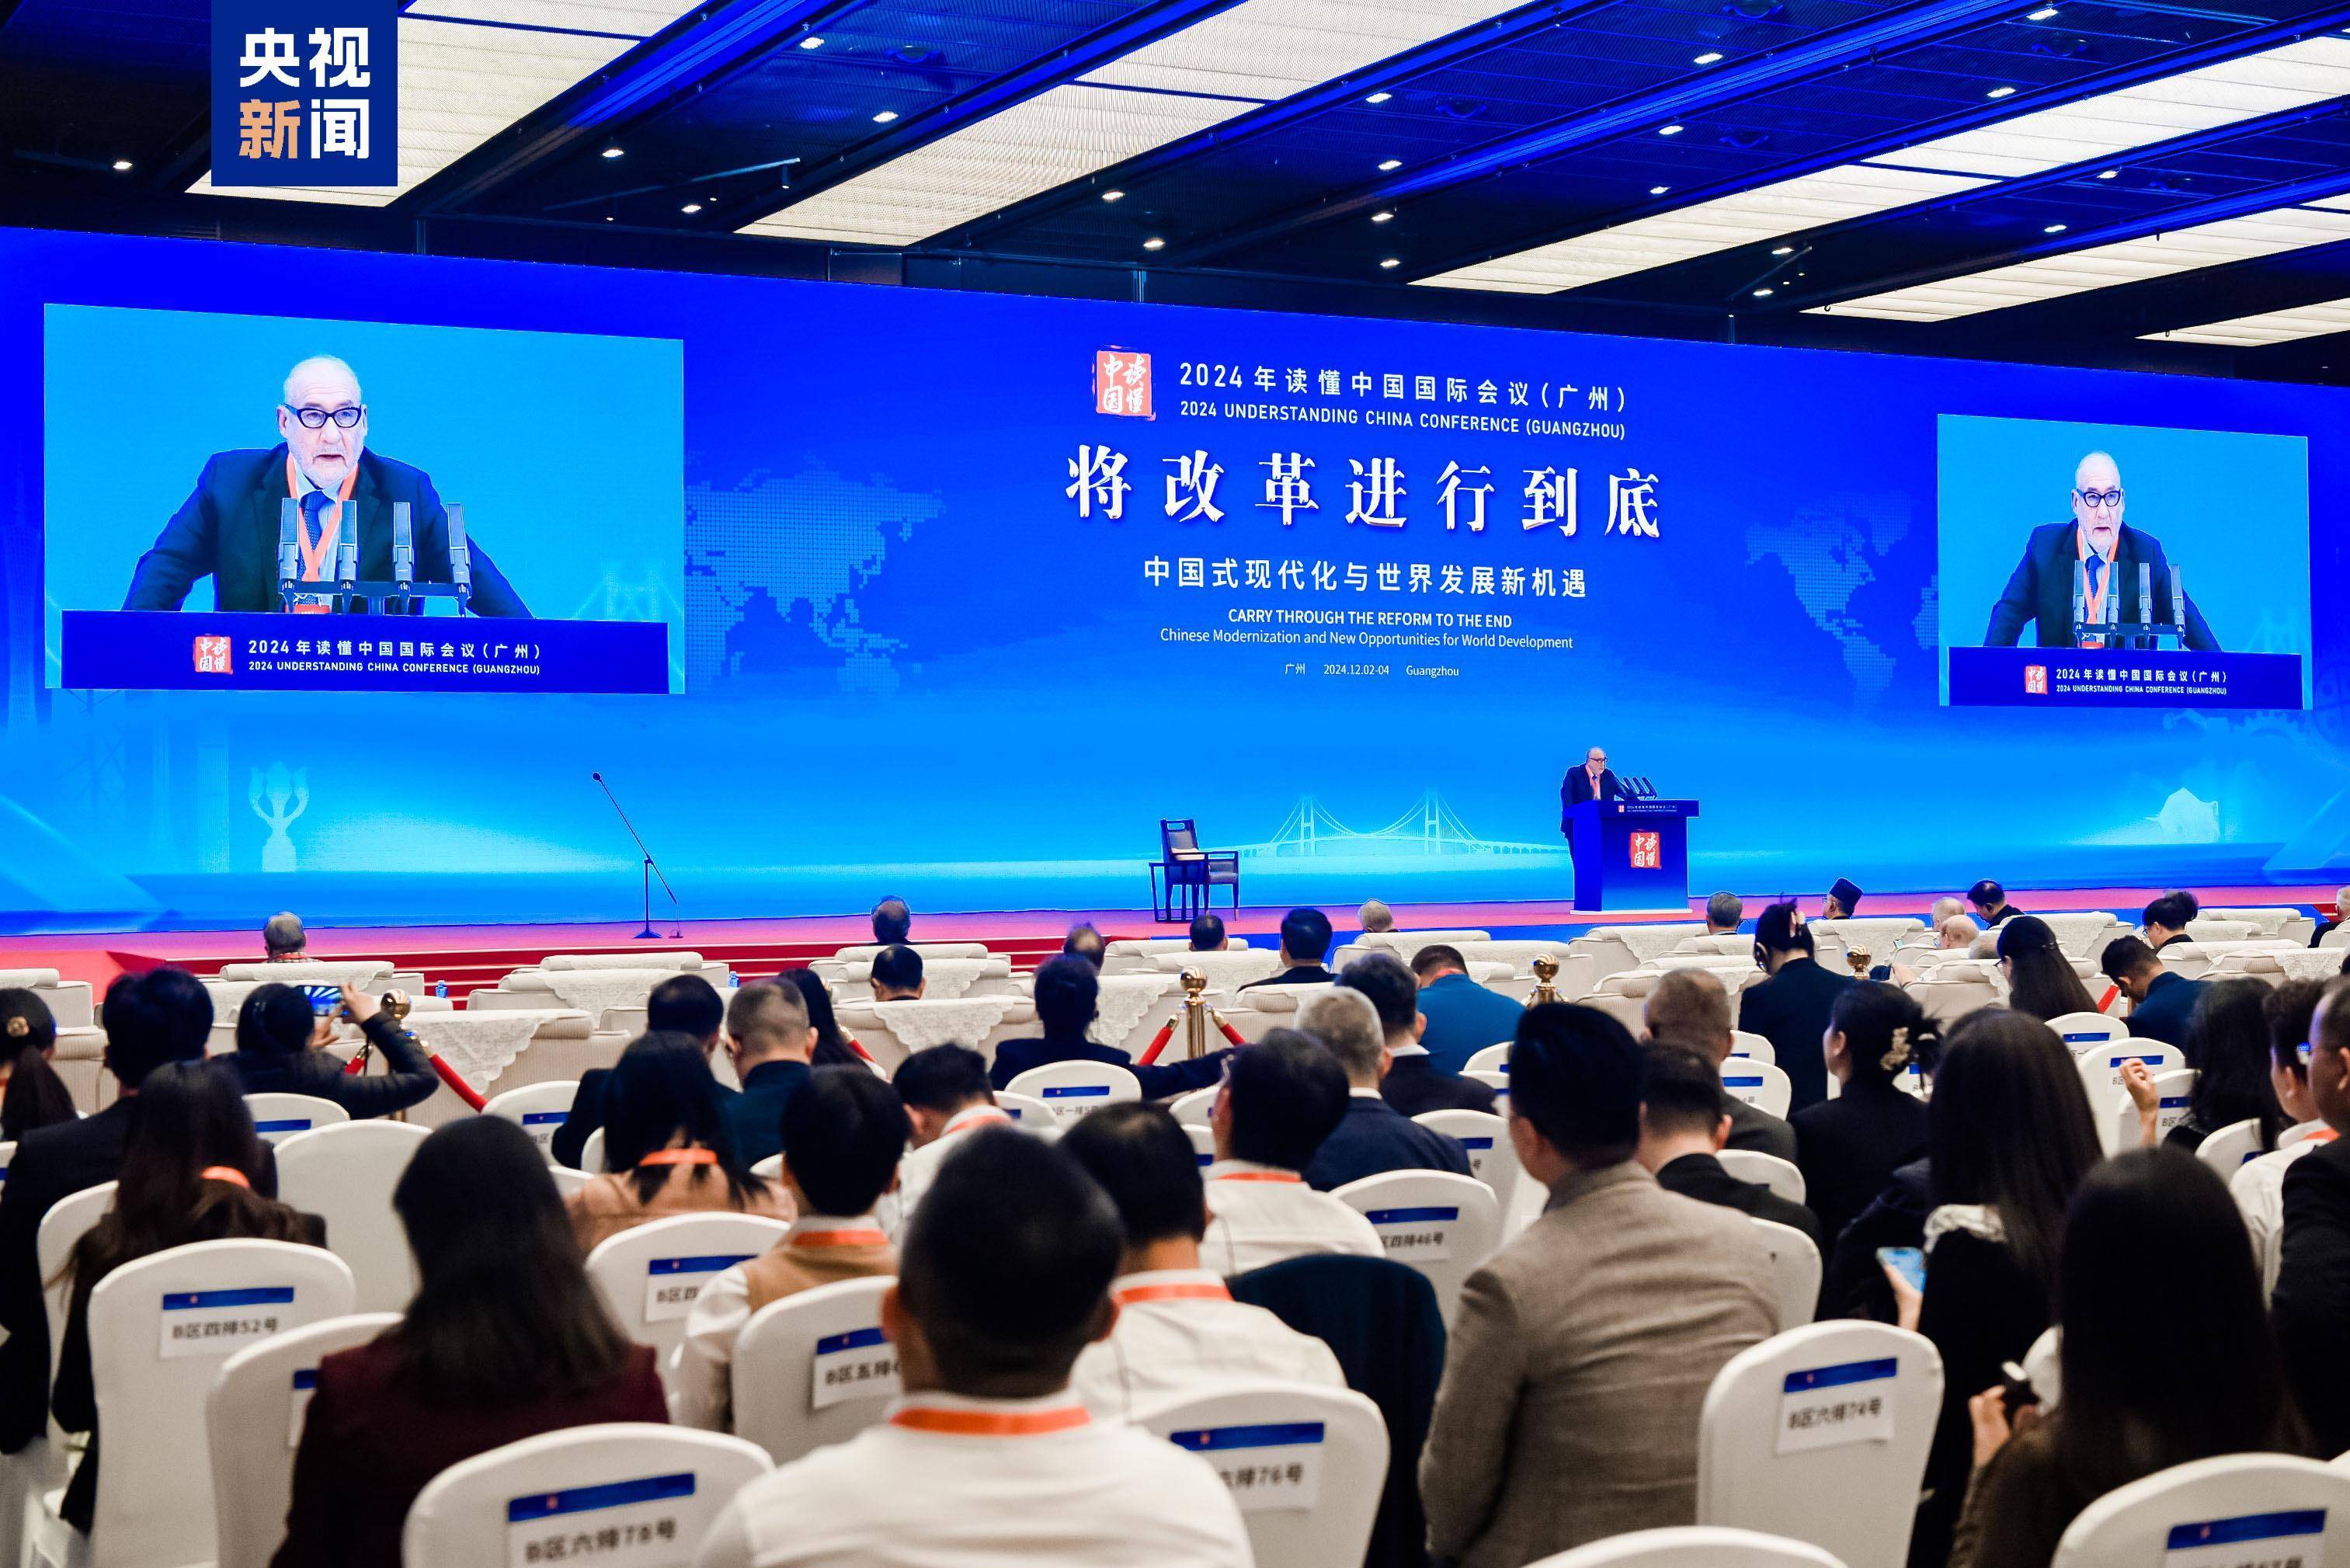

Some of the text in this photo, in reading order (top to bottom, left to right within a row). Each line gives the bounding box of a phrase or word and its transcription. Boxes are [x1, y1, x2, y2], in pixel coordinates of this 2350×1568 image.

[1180, 401, 1625, 440] 2024 UNDERSTANDING CHINA CONFERENCE (GUANGZHOU)
[1065, 444, 1661, 538] 将改革进行到底
[1144, 555, 1587, 598] 中国式现代化与世界发展新机遇
[1228, 608, 1512, 628] CARRY THROUGH THE REFORM TO THE END
[1160, 628, 1573, 651] Chinese Modernization and New Opportunities for World Development
[249, 661, 540, 676] 2024 UNDERSTANDING CHINA CONFERENCE (GUANGZHOU)
[1285, 662, 1305, 675] 广州
[1323, 664, 1389, 675] 2024.12.02-04
[1406, 665, 1459, 679] Guangzhou
[2056, 684, 2071, 693] 2024
[2072, 684, 2123, 693] UNDERSTANDING
[2186, 686, 2227, 696] (GUANGZHOU)
